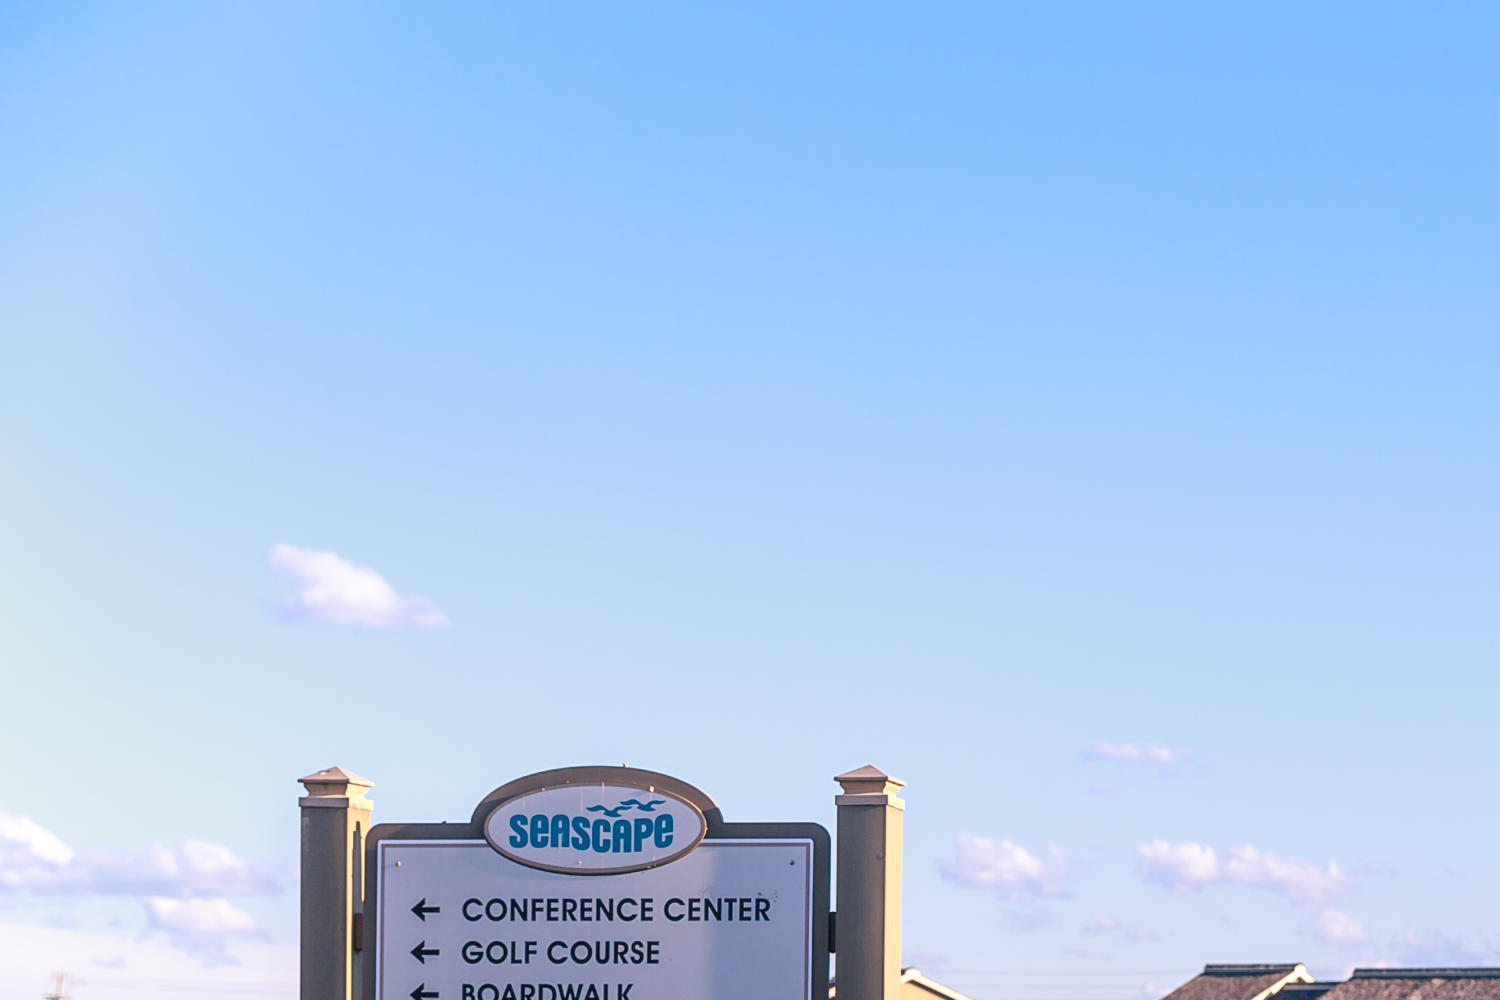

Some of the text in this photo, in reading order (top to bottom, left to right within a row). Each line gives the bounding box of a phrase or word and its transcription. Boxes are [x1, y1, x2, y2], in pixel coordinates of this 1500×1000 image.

[461, 897, 771, 922] CONFERENCE CENTER
[461, 940, 660, 965] GOLF COURSE
